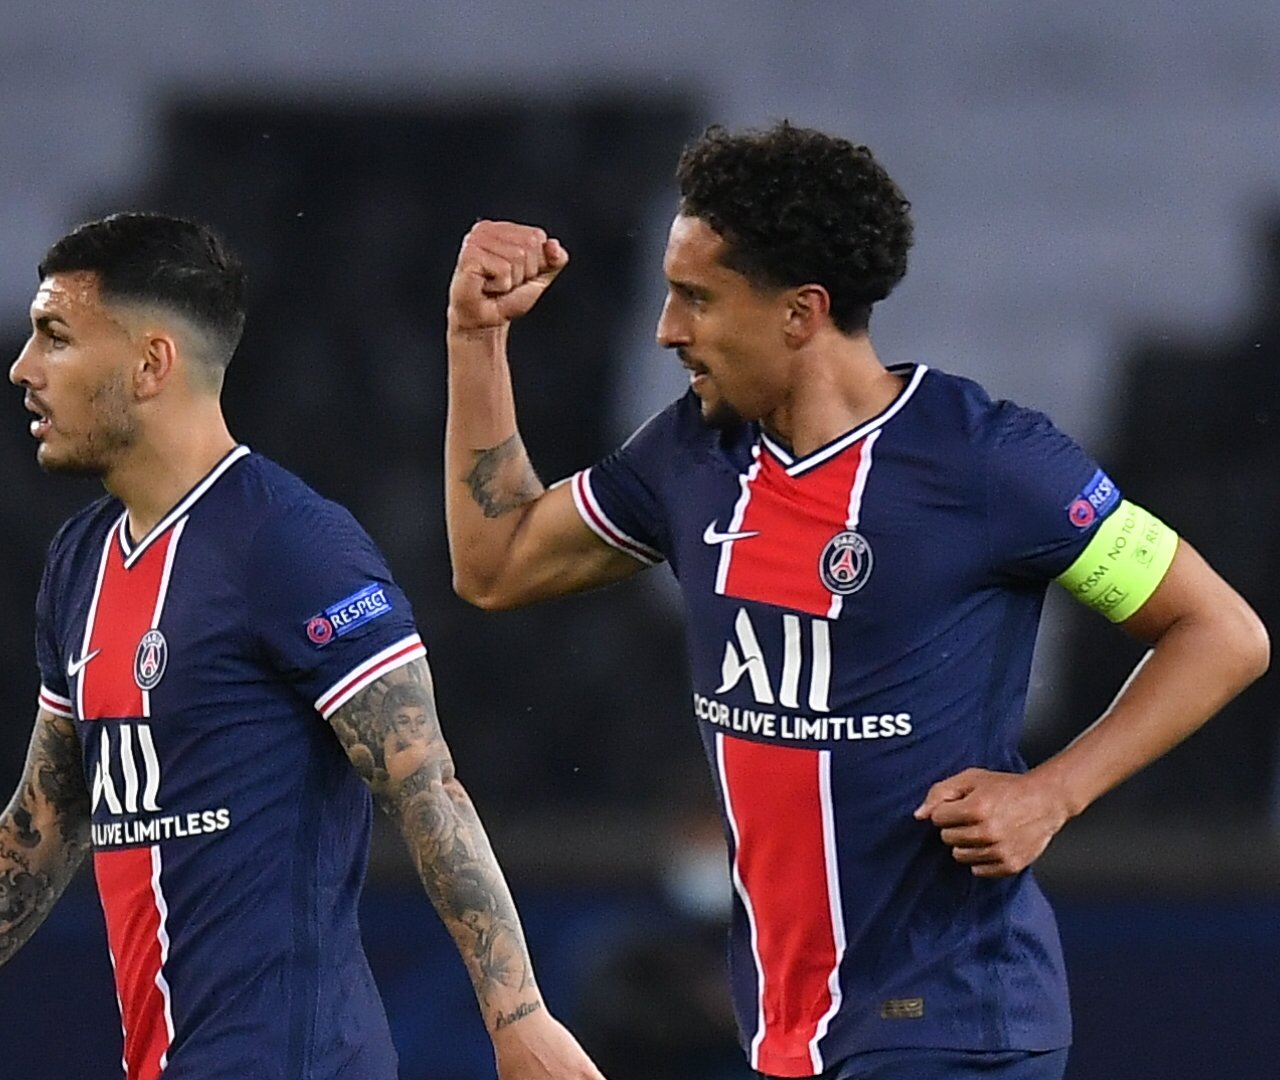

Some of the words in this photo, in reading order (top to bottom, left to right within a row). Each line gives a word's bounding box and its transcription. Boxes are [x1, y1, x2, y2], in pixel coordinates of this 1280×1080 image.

[1088, 475, 1115, 508] RES
[1107, 536, 1127, 561] NO
[330, 588, 387, 629] RESPECT
[732, 707, 777, 737] LIVE
[780, 712, 913, 741] LIMITLESS
[97, 823, 123, 846] LIVE
[124, 808, 231, 843] LIMITLESS
